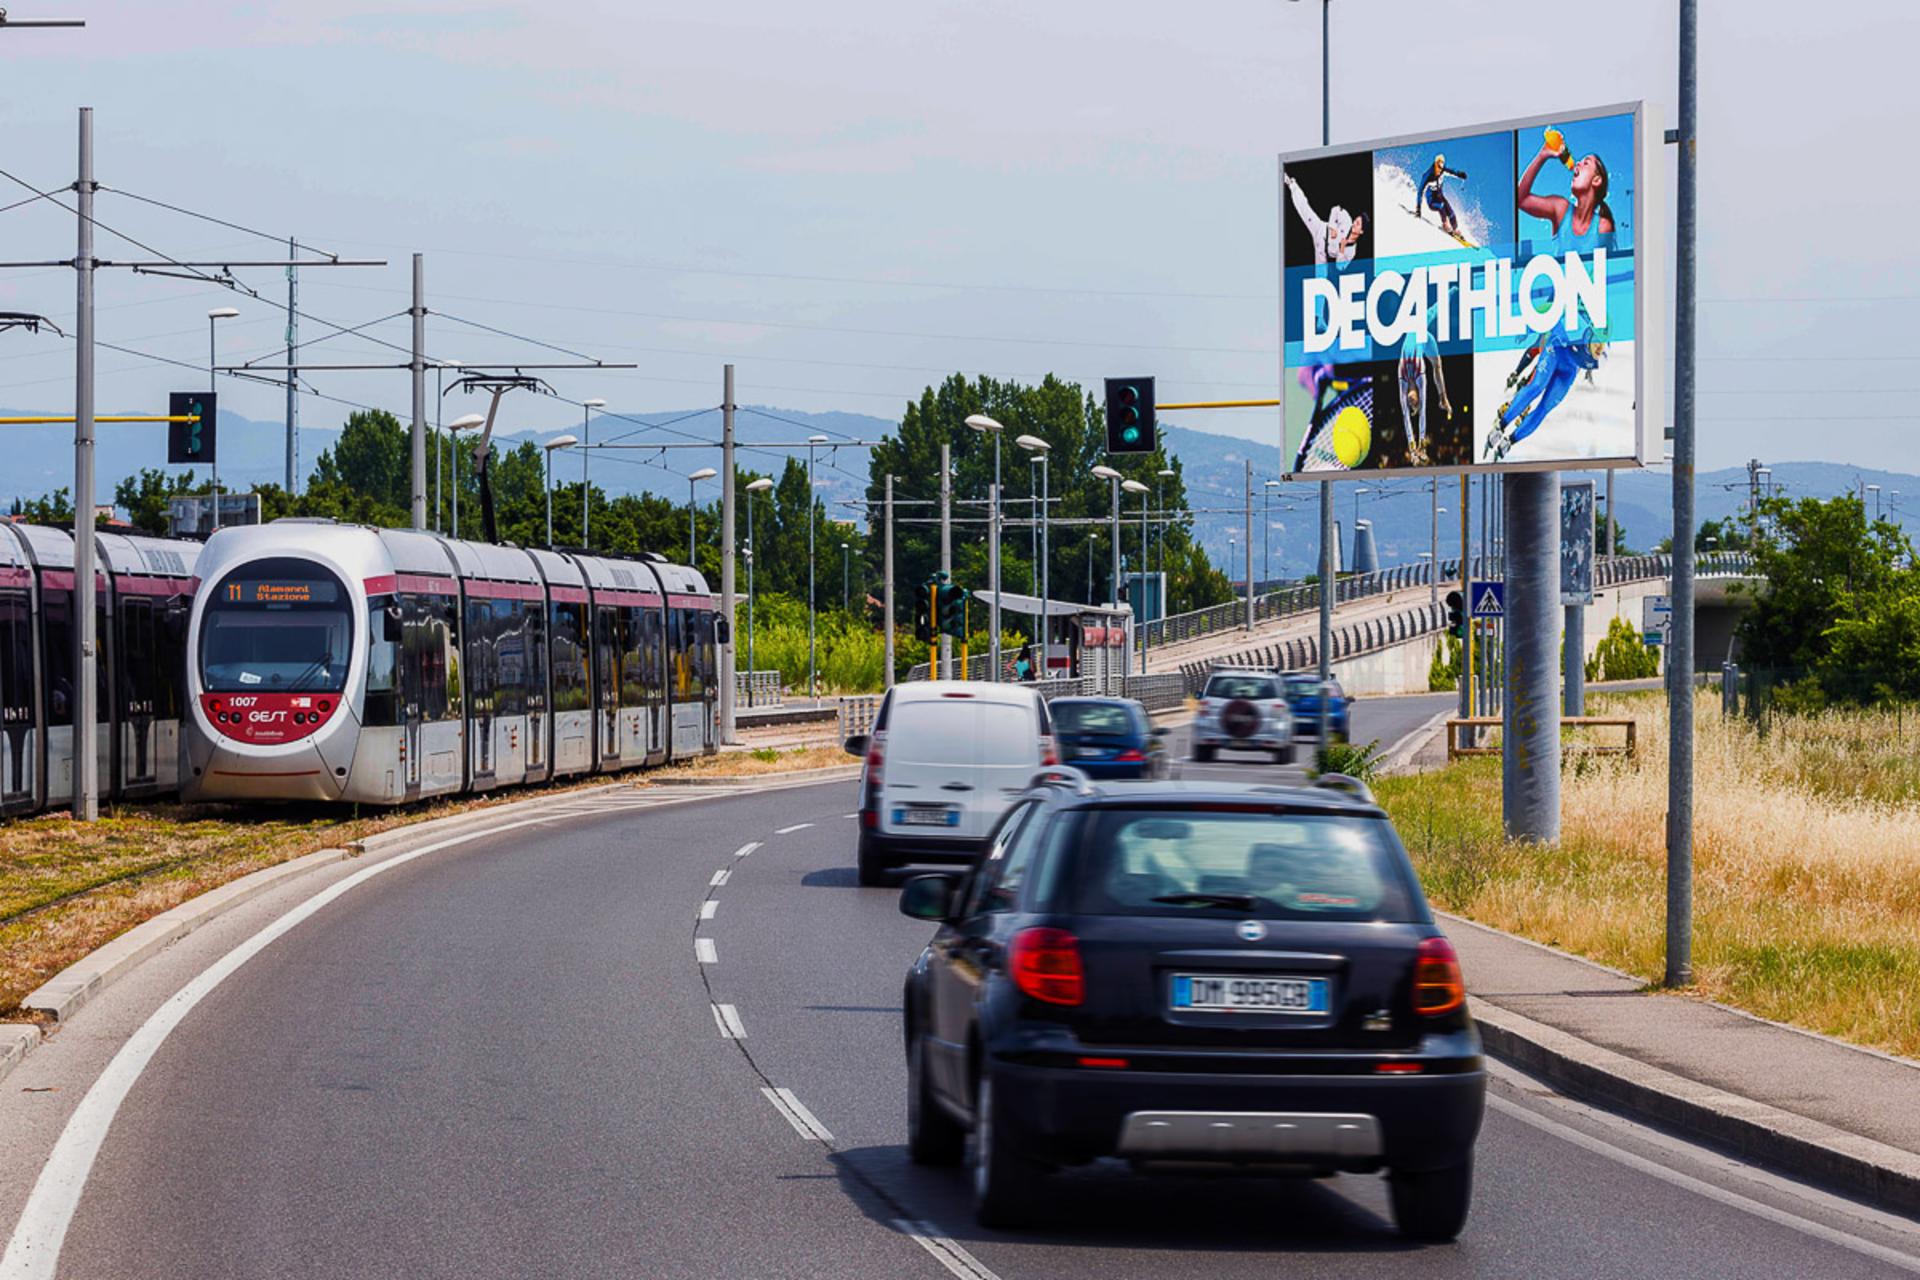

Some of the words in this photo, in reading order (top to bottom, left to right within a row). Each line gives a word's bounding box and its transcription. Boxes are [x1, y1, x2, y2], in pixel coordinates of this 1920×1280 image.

[1302, 247, 1607, 353] DECATHLON
[229, 584, 241, 601] T1
[229, 696, 258, 707] 1007
[248, 710, 288, 722] GEST
